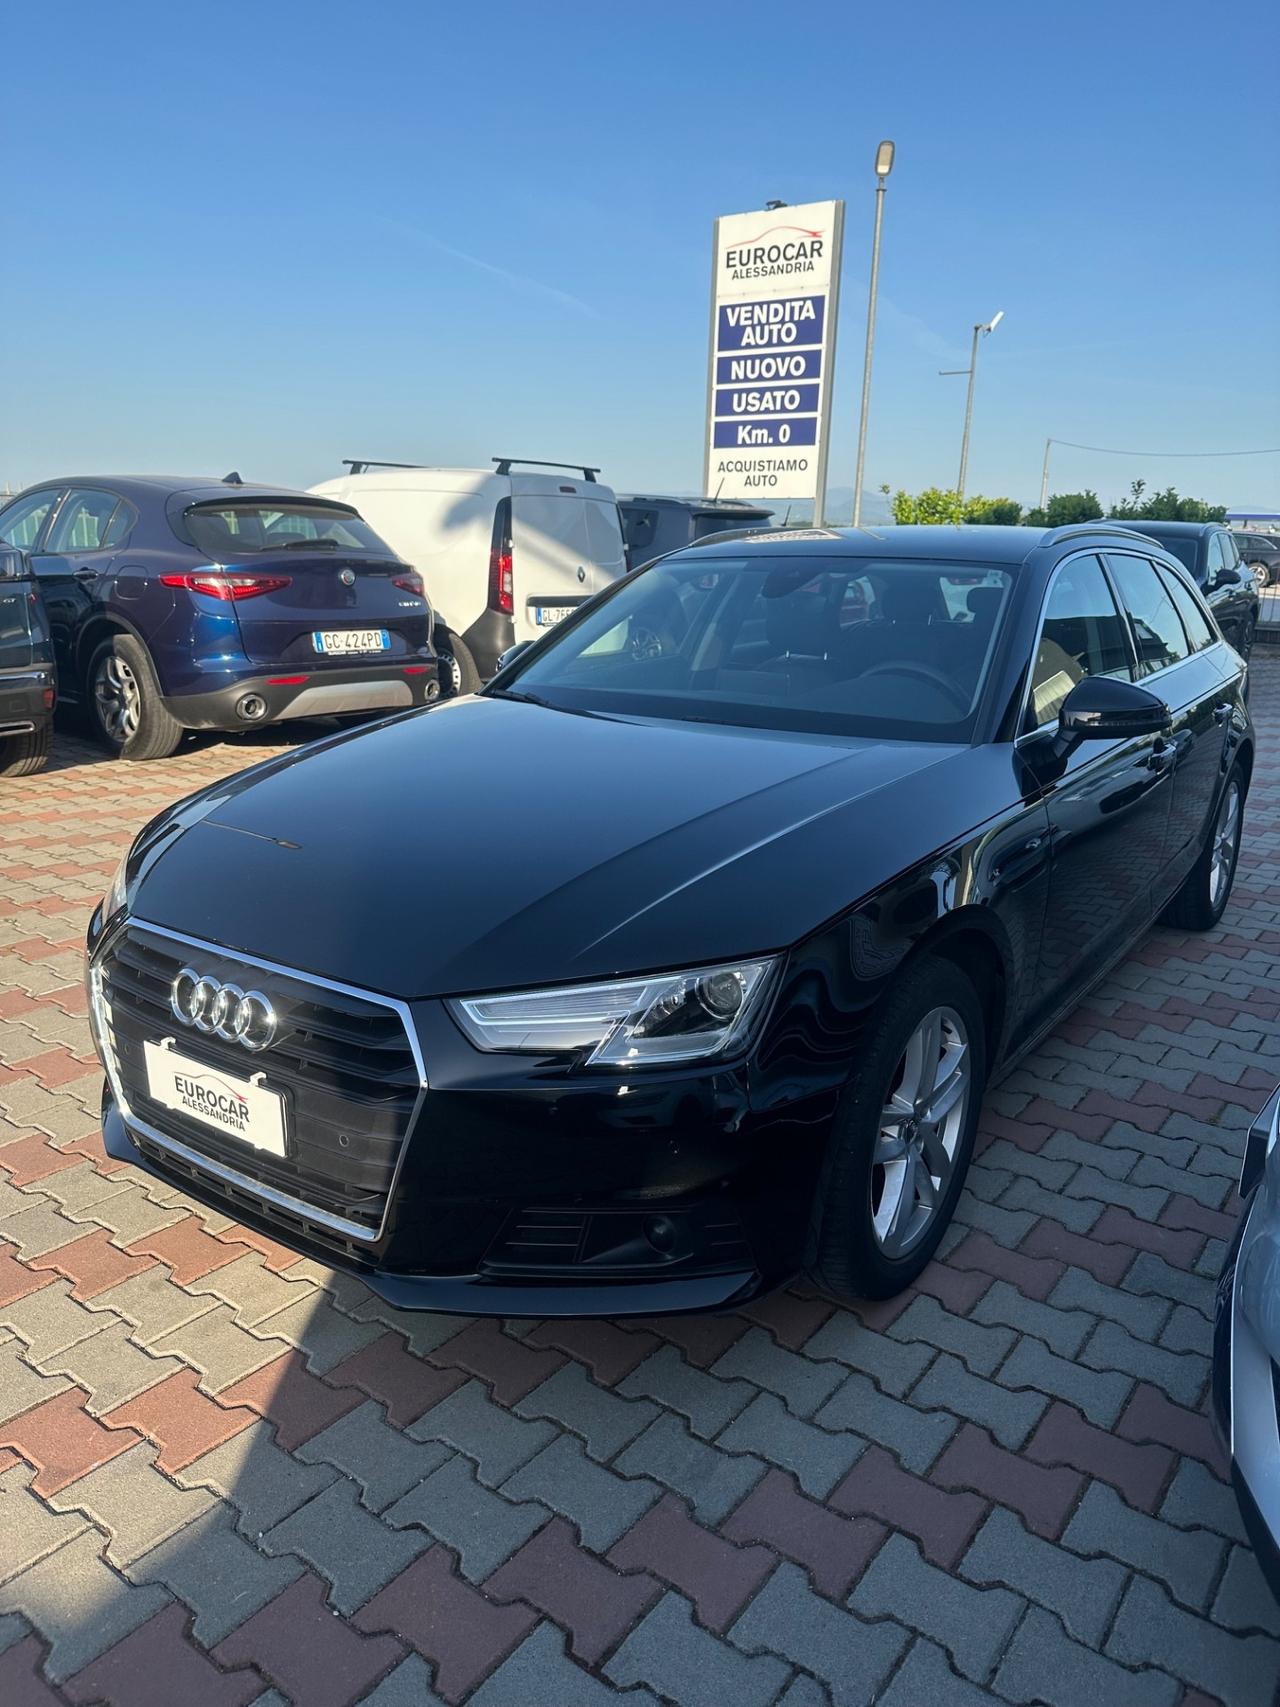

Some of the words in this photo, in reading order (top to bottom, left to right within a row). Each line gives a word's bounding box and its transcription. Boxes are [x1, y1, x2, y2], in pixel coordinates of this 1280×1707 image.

[725, 240, 823, 268] EUROCAR
[731, 261, 815, 280] ALESSANDRIA
[726, 300, 816, 328] VENDITA
[740, 323, 797, 346] AUTO
[730, 356, 806, 380] NUOVO
[732, 390, 801, 413] USATO
[737, 426, 773, 444] Km.
[779, 423, 791, 443] 0
[717, 458, 808, 473] ACQUISTIAMO
[743, 474, 778, 487] AUTO
[174, 1075, 250, 1122] EUROCAR
[181, 1096, 246, 1131] ALESSANDRIA
